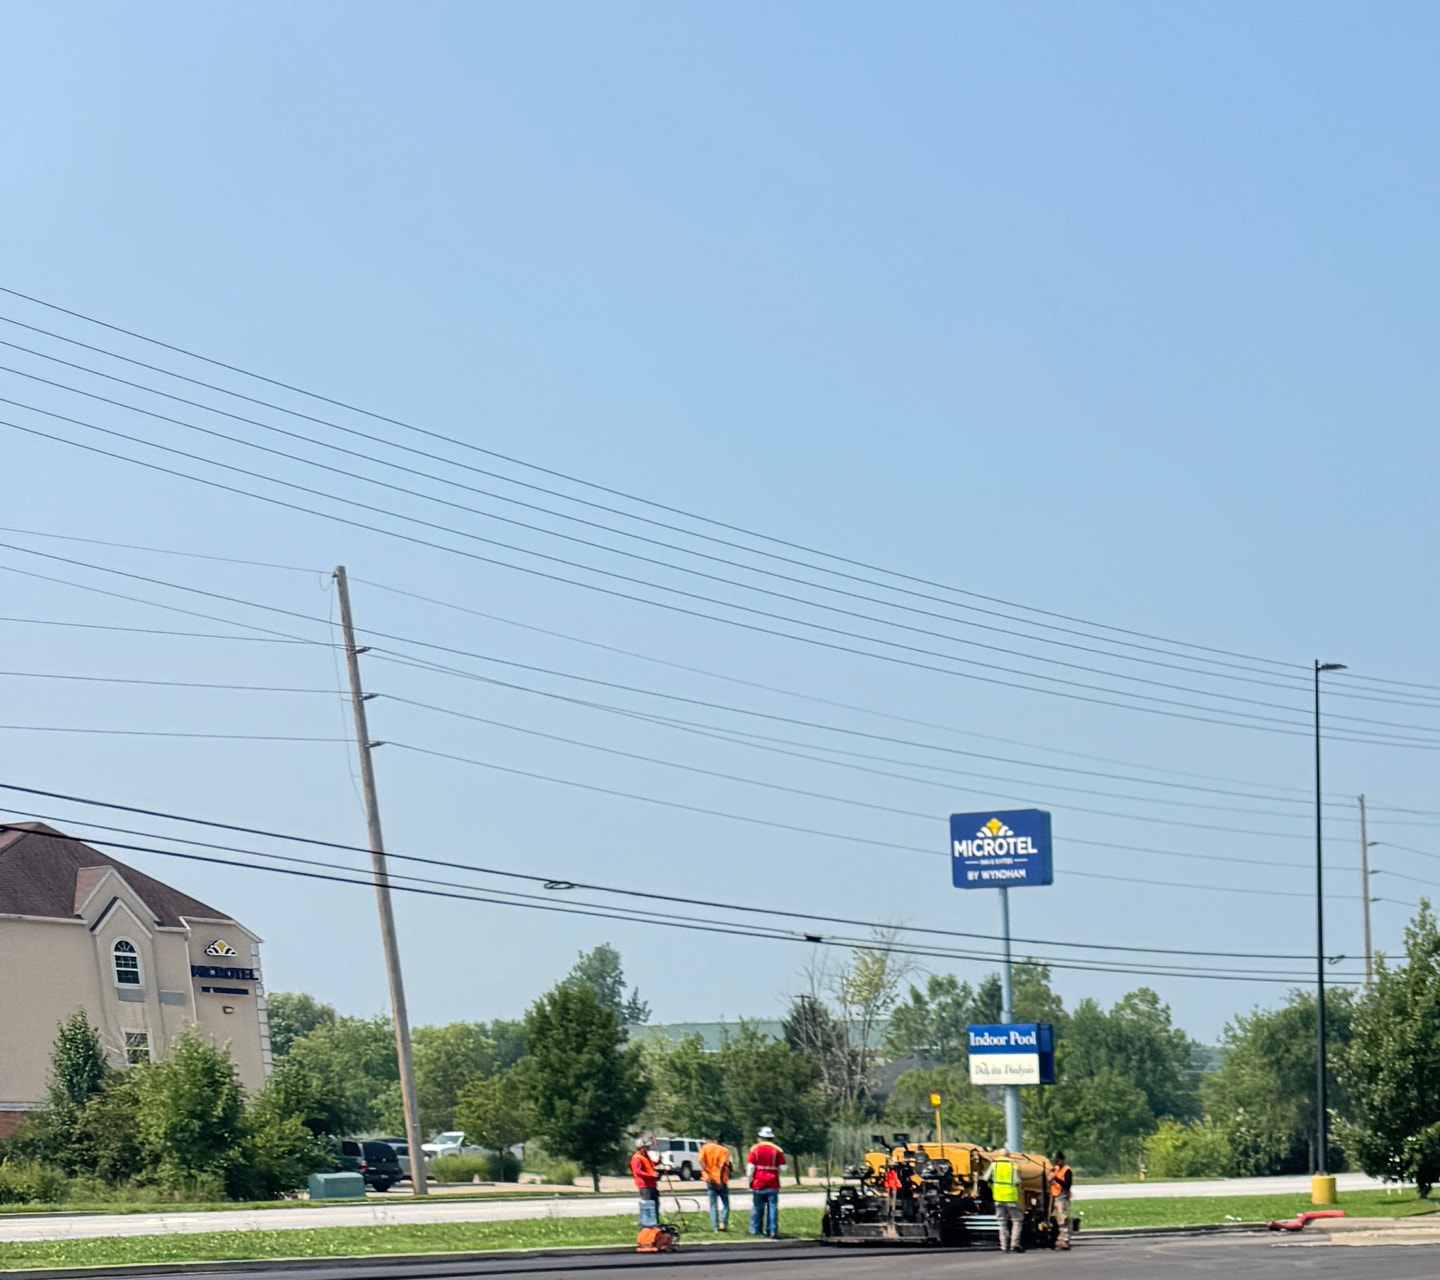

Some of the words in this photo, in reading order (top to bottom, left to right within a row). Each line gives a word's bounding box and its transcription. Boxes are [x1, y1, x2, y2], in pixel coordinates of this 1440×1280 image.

[954, 837, 1038, 857] MICROTEL
[967, 871, 979, 880] BY
[981, 869, 1026, 880] WYNDHAM
[969, 1032, 1008, 1046] Indoor
[1009, 1031, 1036, 1045] Pool
